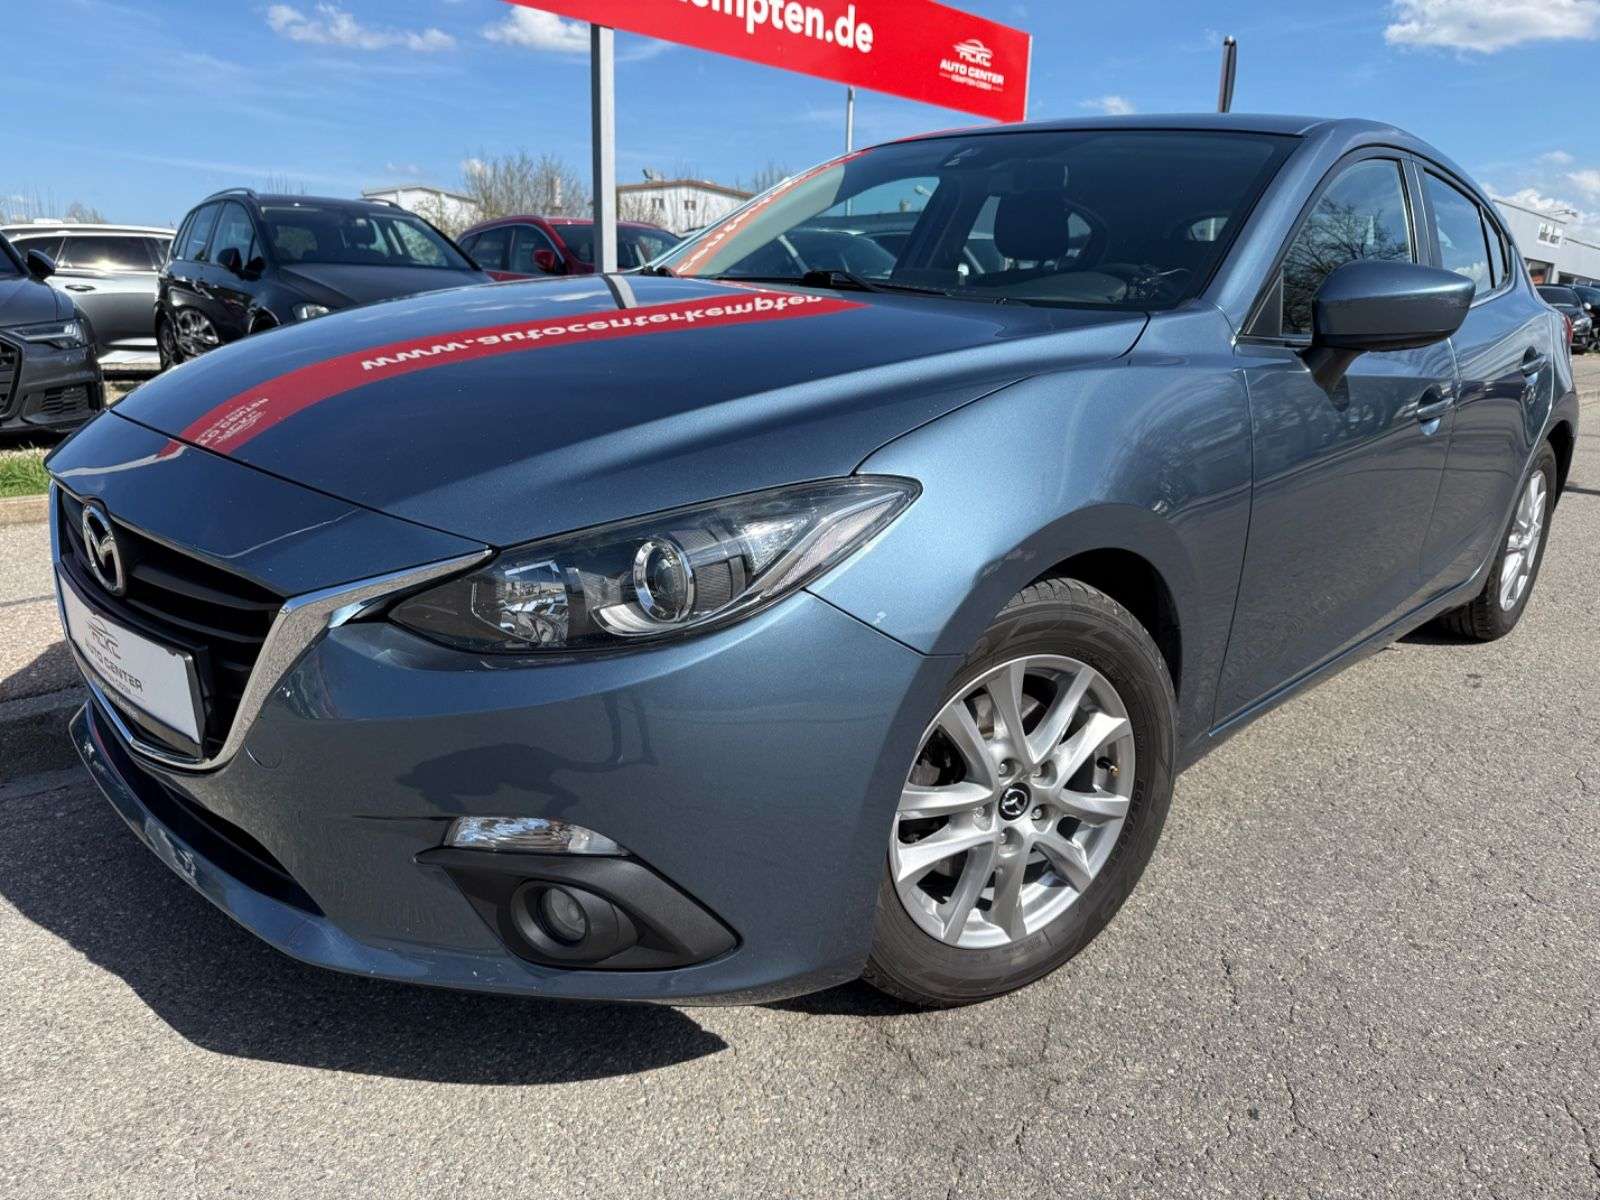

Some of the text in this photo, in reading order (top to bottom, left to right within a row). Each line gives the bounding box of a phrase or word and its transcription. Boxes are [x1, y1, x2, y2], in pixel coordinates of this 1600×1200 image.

[940, 59, 968, 76] AUTO
[968, 66, 1005, 86] CENTER
[103, 656, 144, 692] CENTER
